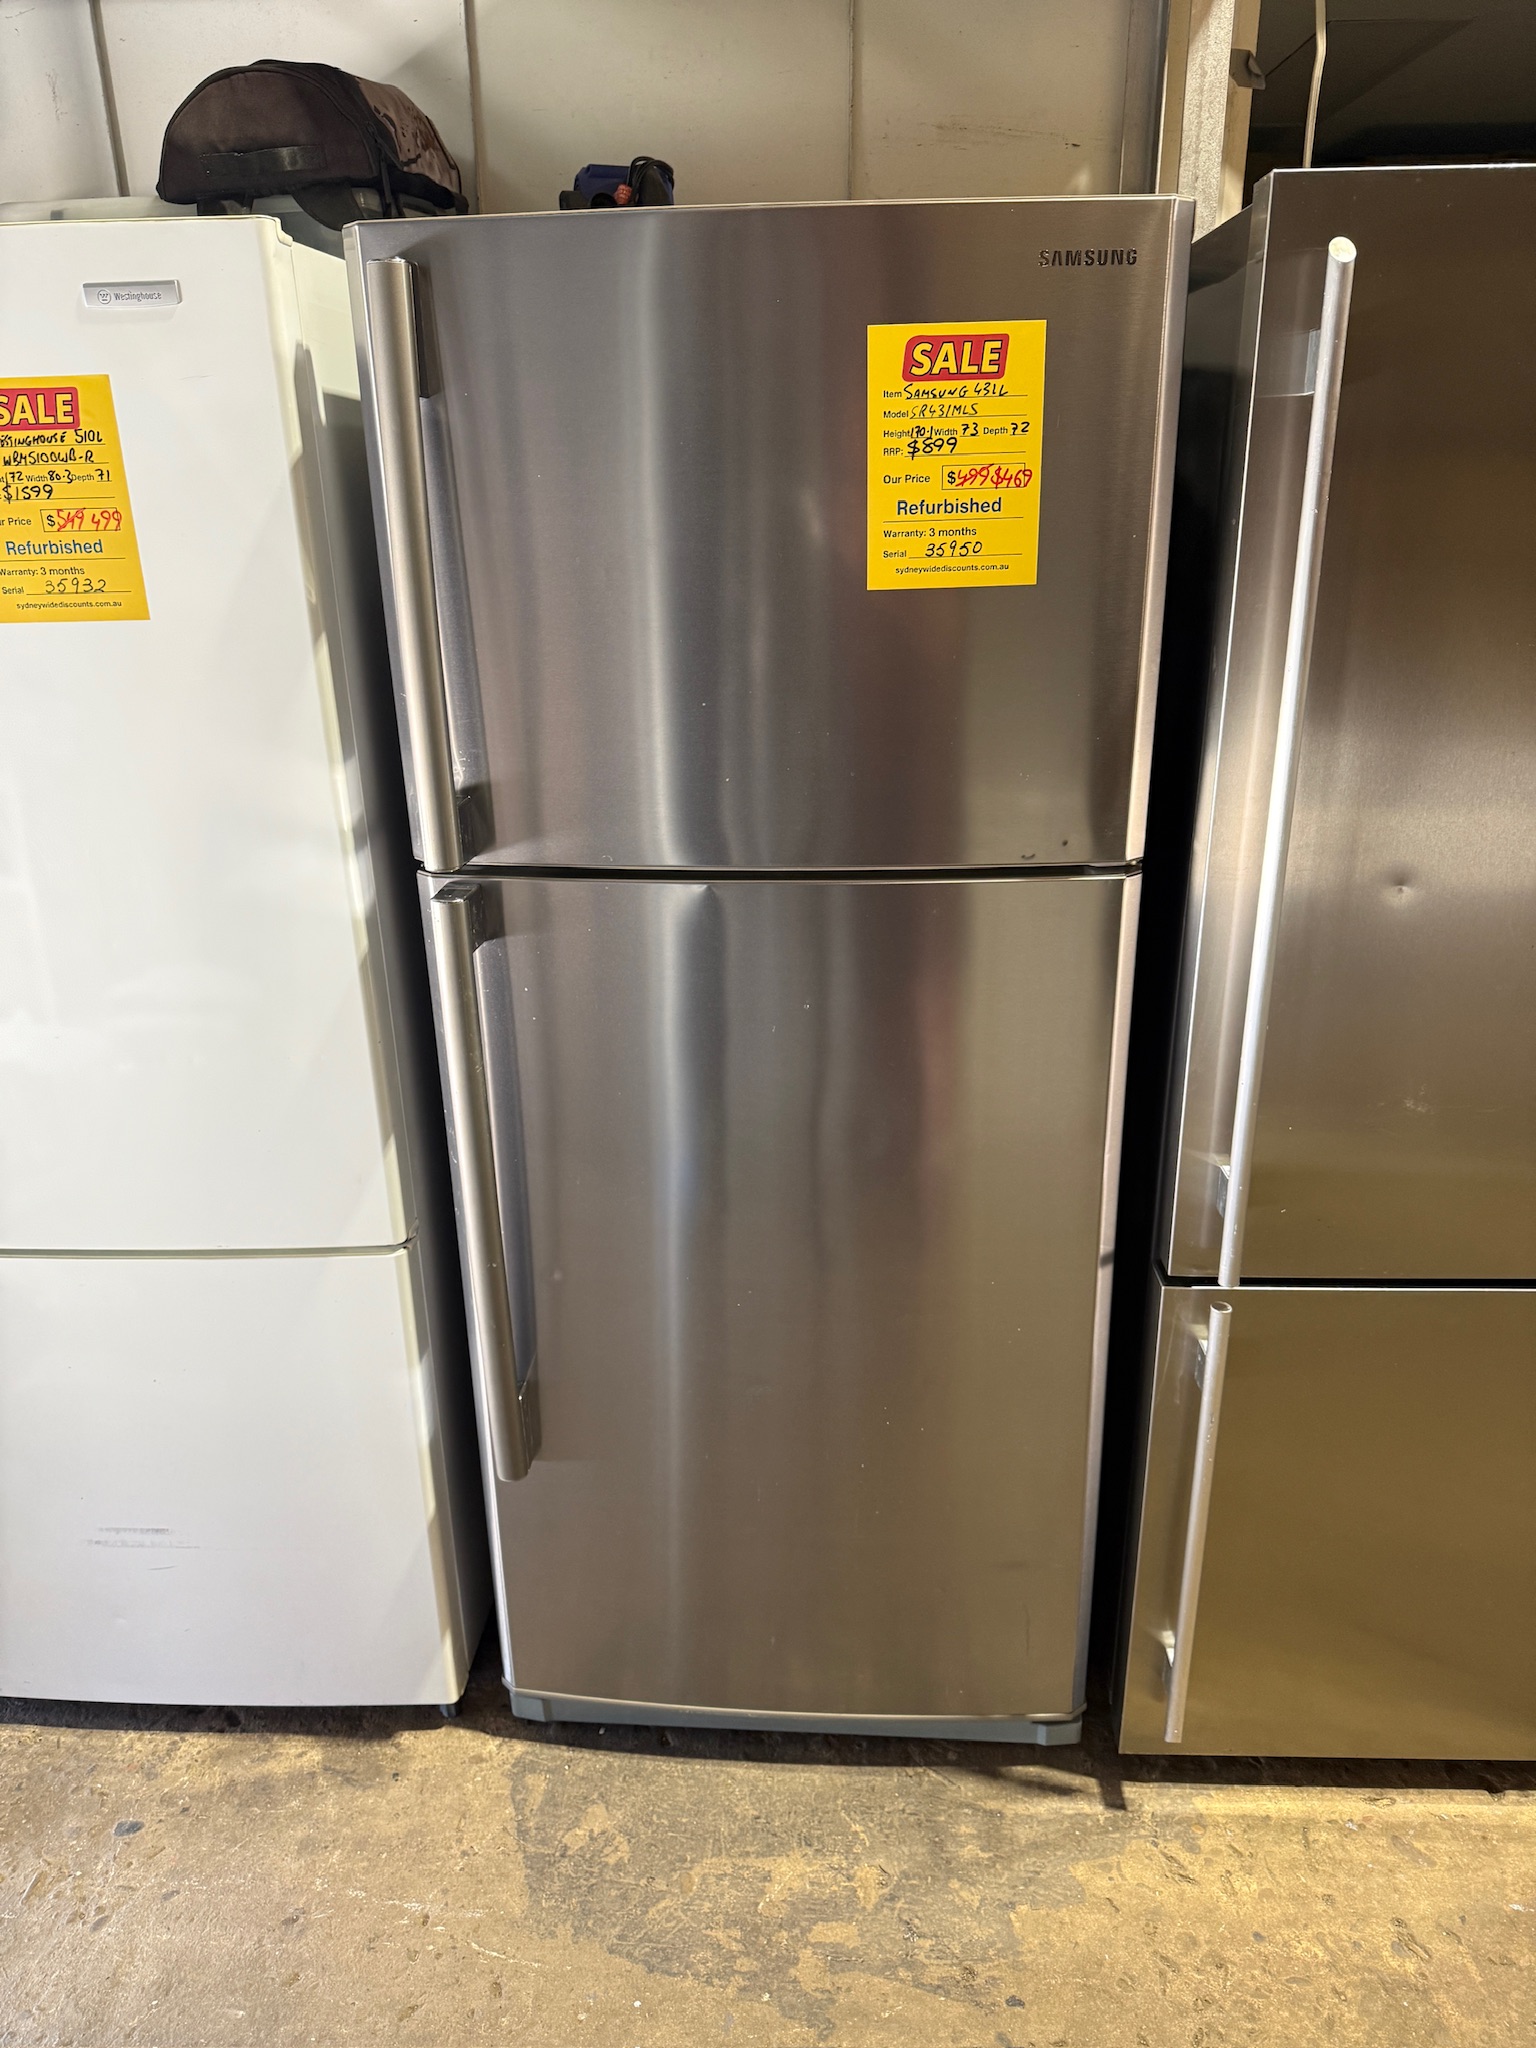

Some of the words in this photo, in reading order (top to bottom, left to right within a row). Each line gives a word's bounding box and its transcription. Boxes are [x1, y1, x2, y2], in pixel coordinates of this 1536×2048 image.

[1039, 249, 1137, 267] SAMSUNG
[114, 291, 162, 303] Westinghouse
[909, 339, 1003, 377] SALE
[883, 390, 902, 398] Item
[903, 383, 969, 400] SAMSUNG
[883, 410, 909, 419] Model
[883, 430, 911, 440] Height
[934, 428, 958, 437] Width
[961, 422, 979, 437] 73
[983, 427, 1008, 438] Depth
[1010, 421, 1031, 435] 72
[883, 447, 903, 456] RRP:
[907, 437, 958, 460] $899
[25, 474, 49, 482] Width
[72, 474, 94, 482] Depth
[95, 468, 110, 482] 71
[883, 474, 901, 484] Our
[904, 474, 931, 483] Price
[2, 483, 53, 504] $1599
[897, 497, 1002, 516] Refurbished
[8, 516, 32, 526] Price
[91, 510, 122, 532] 499
[883, 529, 926, 539] Warranty:
[929, 528, 936, 537] 3
[938, 527, 977, 537] months
[6, 539, 104, 556] Refurbished
[883, 550, 907, 559] Serial
[925, 540, 983, 558] 35950
[41, 567, 47, 575] 3
[49, 567, 85, 576] months
[895, 563, 1009, 576] sydneywidediscounts.com.au
[2, 586, 24, 595] Serial
[45, 577, 107, 594] 35932
[16, 600, 122, 610] sydneywidediscounts.com.au
